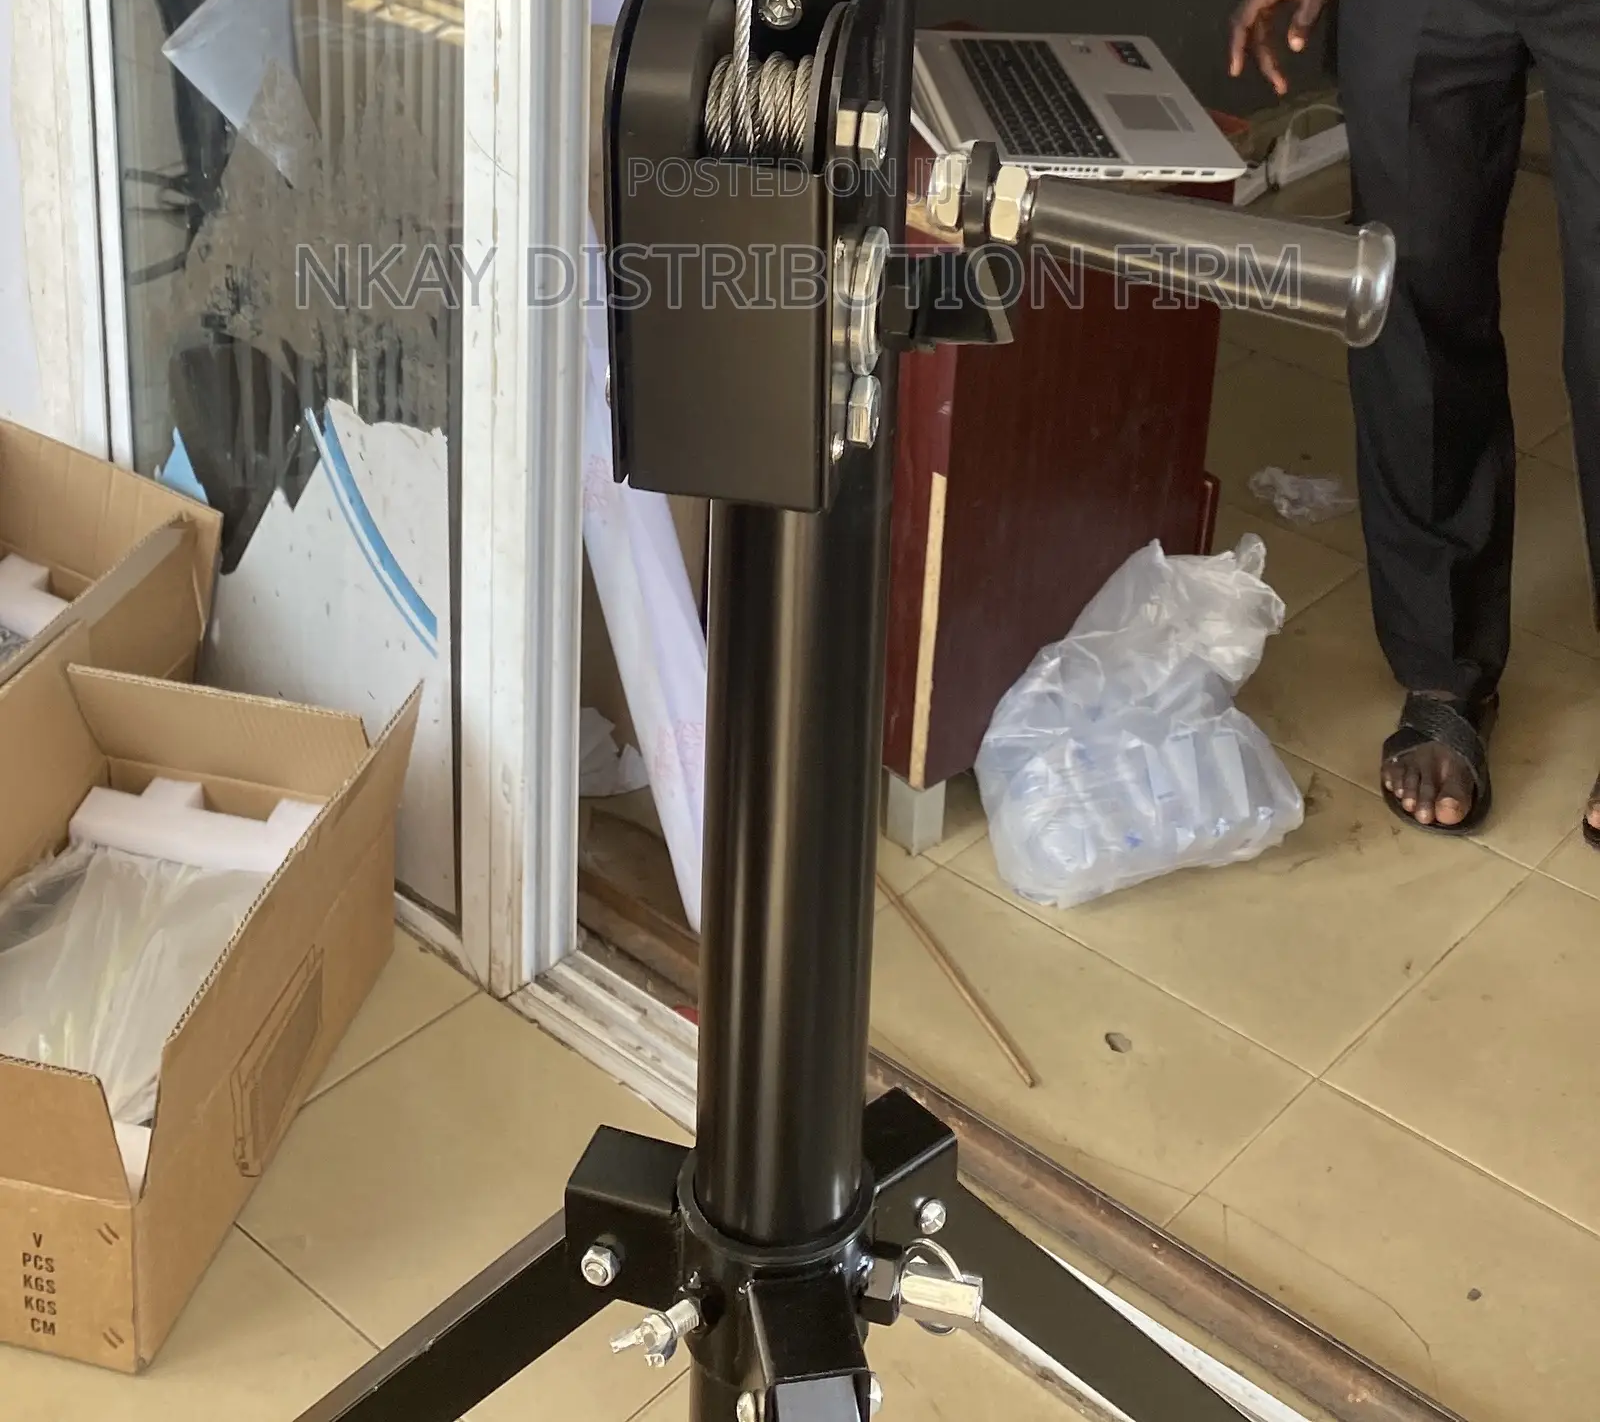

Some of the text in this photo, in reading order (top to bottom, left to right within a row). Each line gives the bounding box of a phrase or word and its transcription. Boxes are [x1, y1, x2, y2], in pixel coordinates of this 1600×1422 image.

[32, 1232, 43, 1249] V
[22, 1252, 56, 1274] PCS
[22, 1274, 57, 1295] KGS
[24, 1295, 58, 1317] KGS
[30, 1317, 57, 1336] CM
